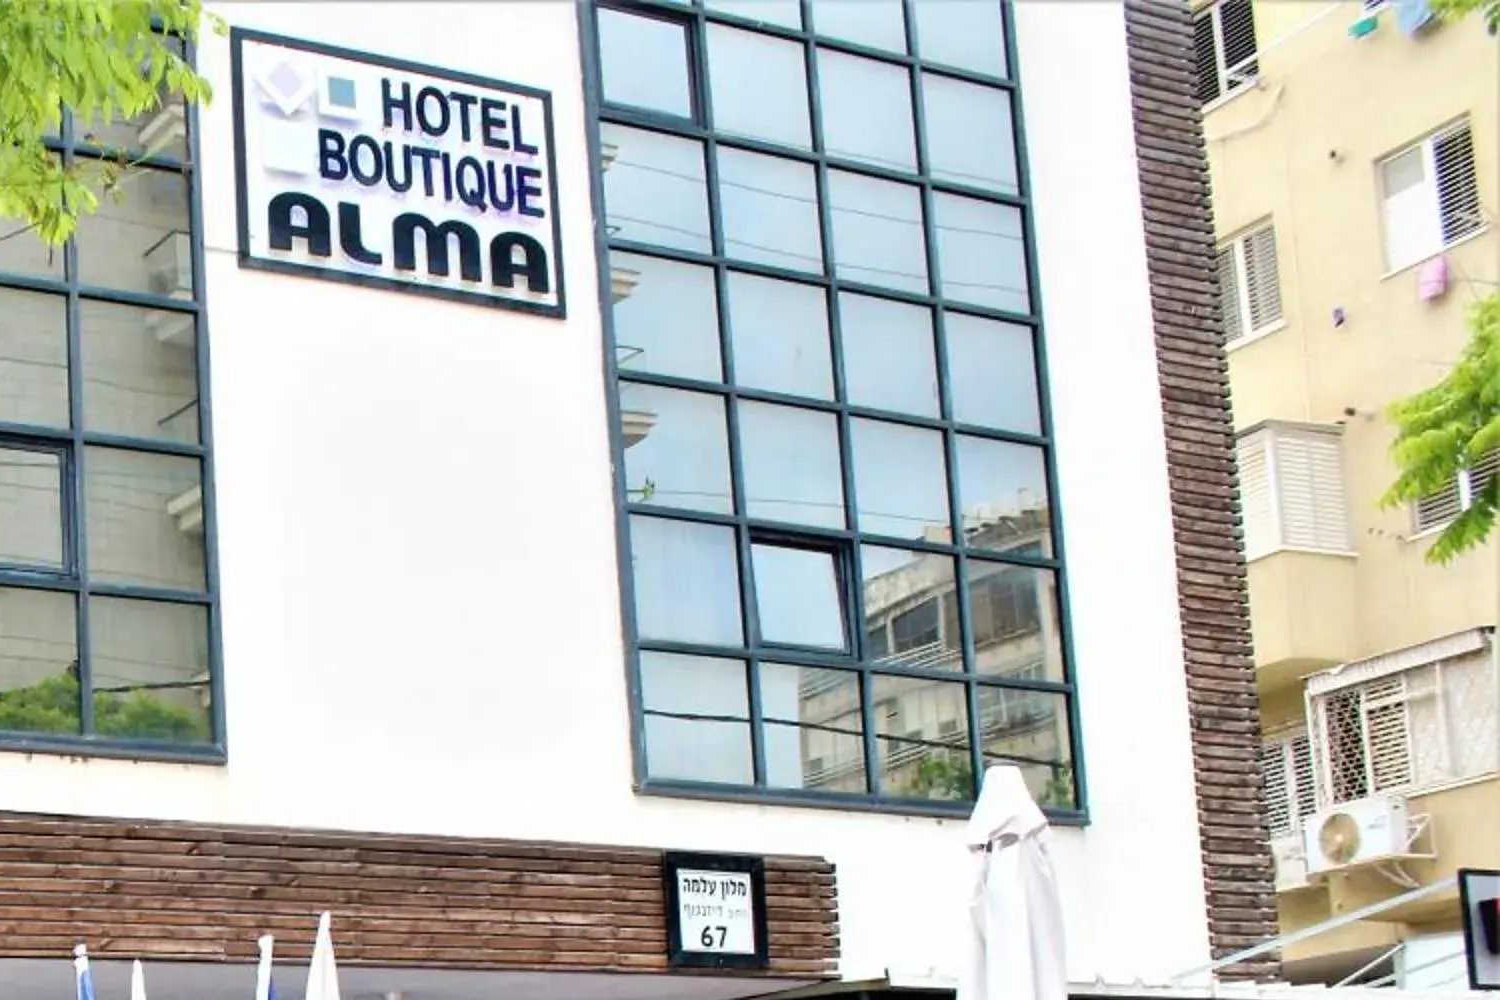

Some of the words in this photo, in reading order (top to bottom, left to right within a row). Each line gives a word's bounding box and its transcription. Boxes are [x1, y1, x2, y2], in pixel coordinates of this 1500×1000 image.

[381, 77, 539, 156] HOTEL
[318, 127, 545, 219] BOUTIQUE
[267, 191, 549, 294] ALMA
[683, 877, 717, 896] עלמה
[720, 879, 747, 900] מלון
[700, 925, 728, 949] 67
